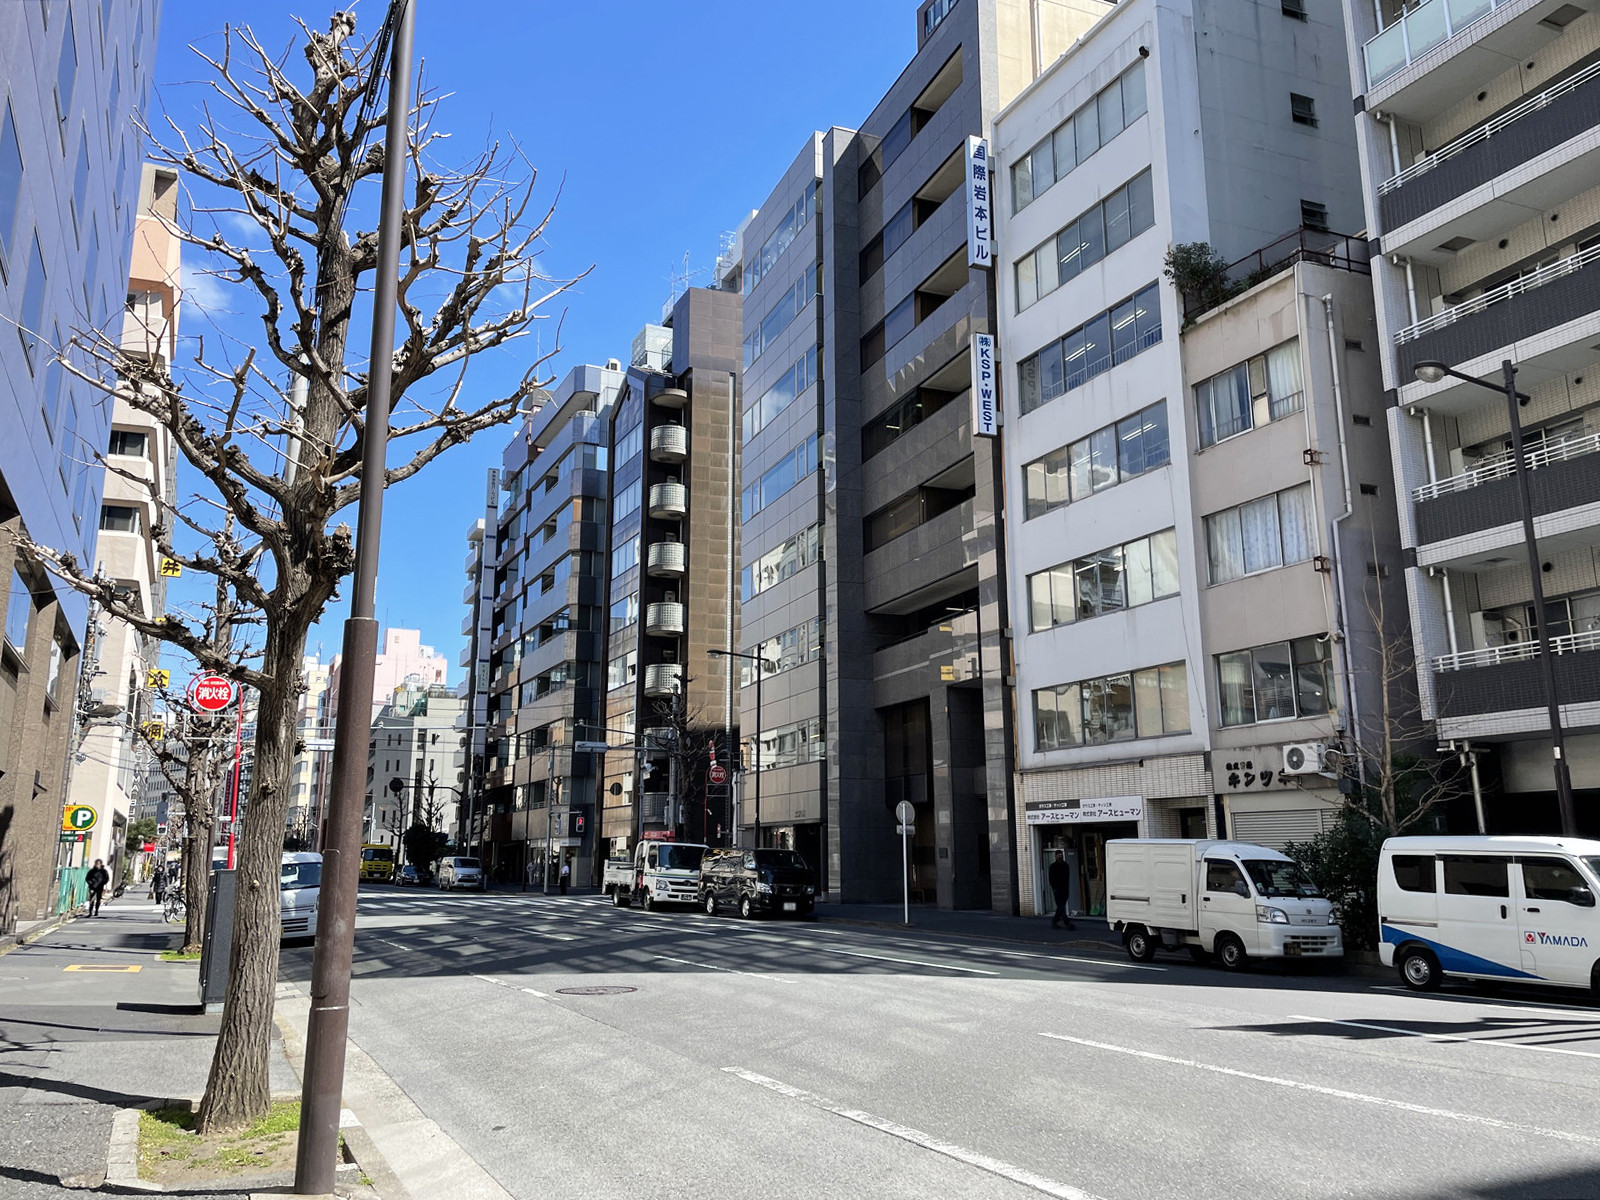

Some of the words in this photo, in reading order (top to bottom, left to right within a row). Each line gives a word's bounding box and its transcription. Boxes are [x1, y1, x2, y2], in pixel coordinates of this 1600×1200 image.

[972, 144, 989, 261] 国際岩本ビル
[198, 686, 230, 700] 消火栓
[76, 810, 92, 827] P
[1040, 811, 1080, 821] アースヒューマン
[1097, 808, 1142, 818] アースヒューマン
[1537, 931, 1588, 948] YAMADA
